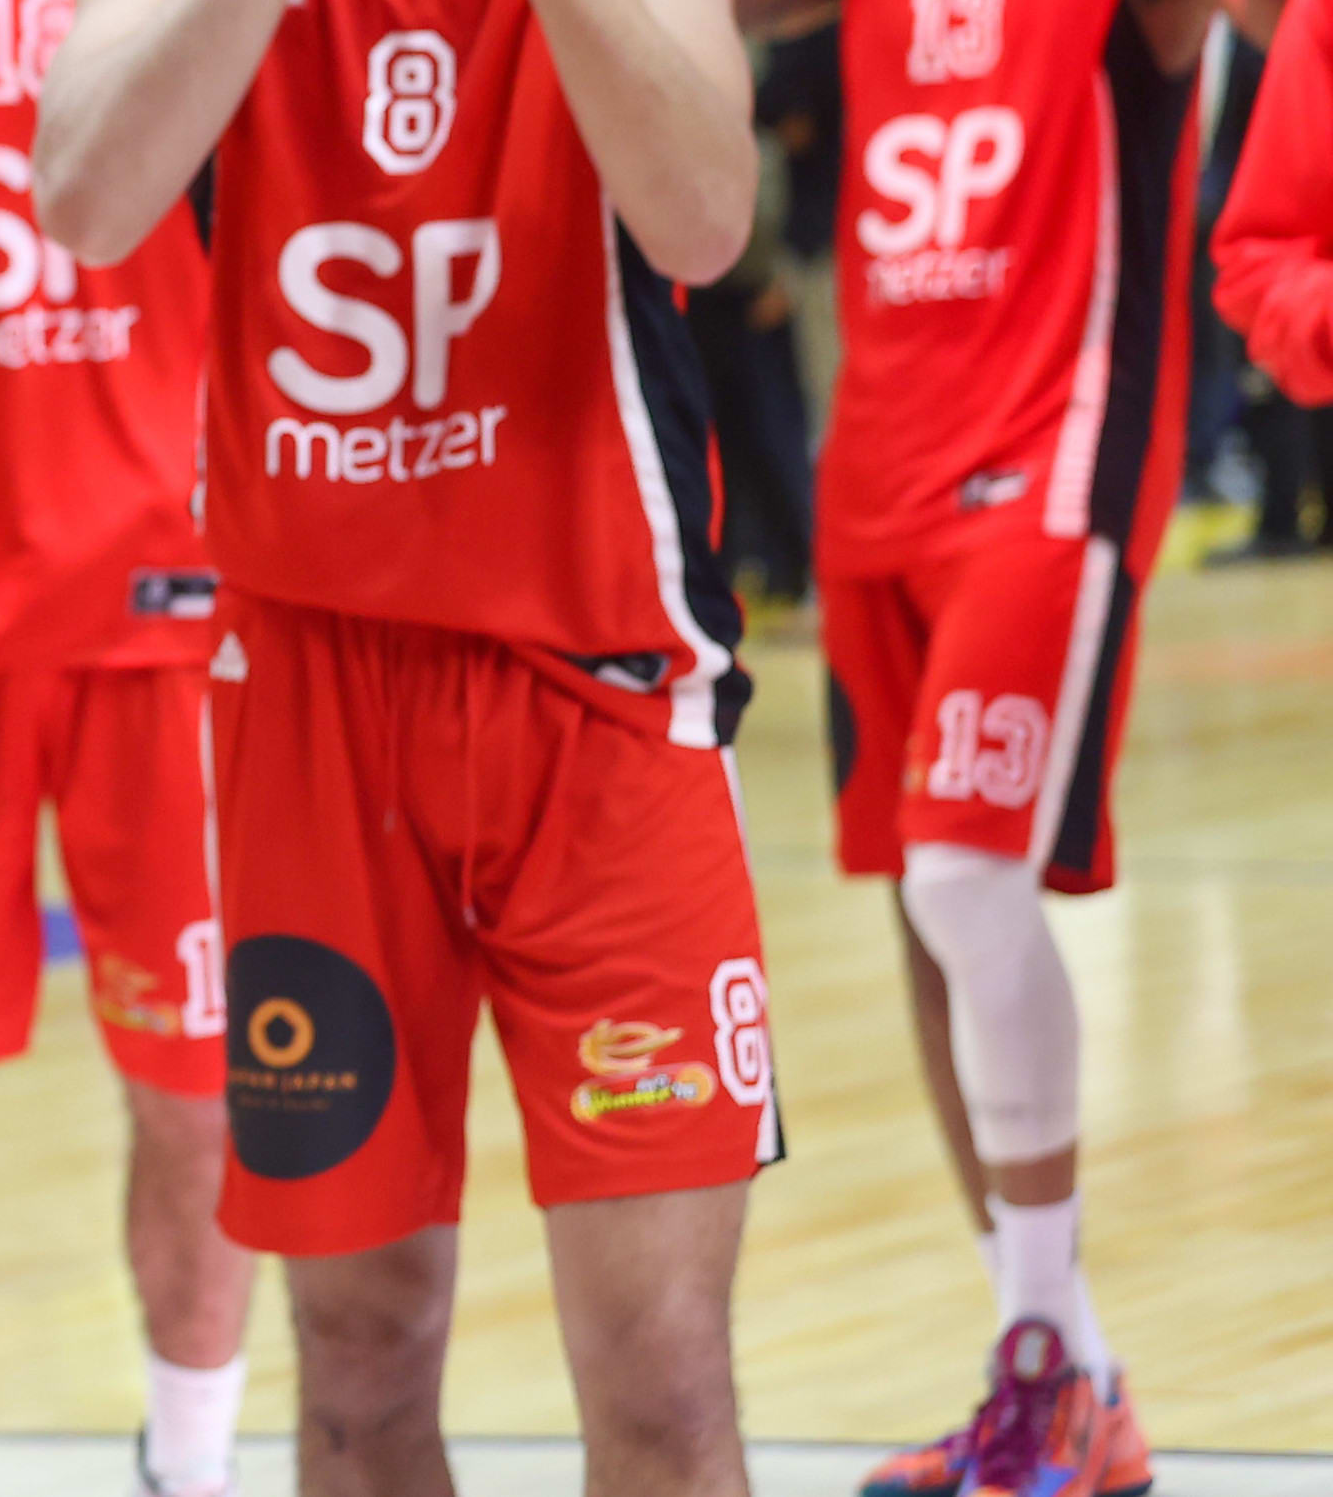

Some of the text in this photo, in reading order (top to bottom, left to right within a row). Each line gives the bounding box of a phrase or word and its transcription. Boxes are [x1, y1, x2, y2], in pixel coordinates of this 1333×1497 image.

[362, 30, 458, 176] 8
[855, 105, 1025, 256] SP
[267, 217, 502, 415] SP
[265, 404, 508, 484] metzer
[927, 689, 1049, 811] 13
[709, 956, 768, 1106] 8
